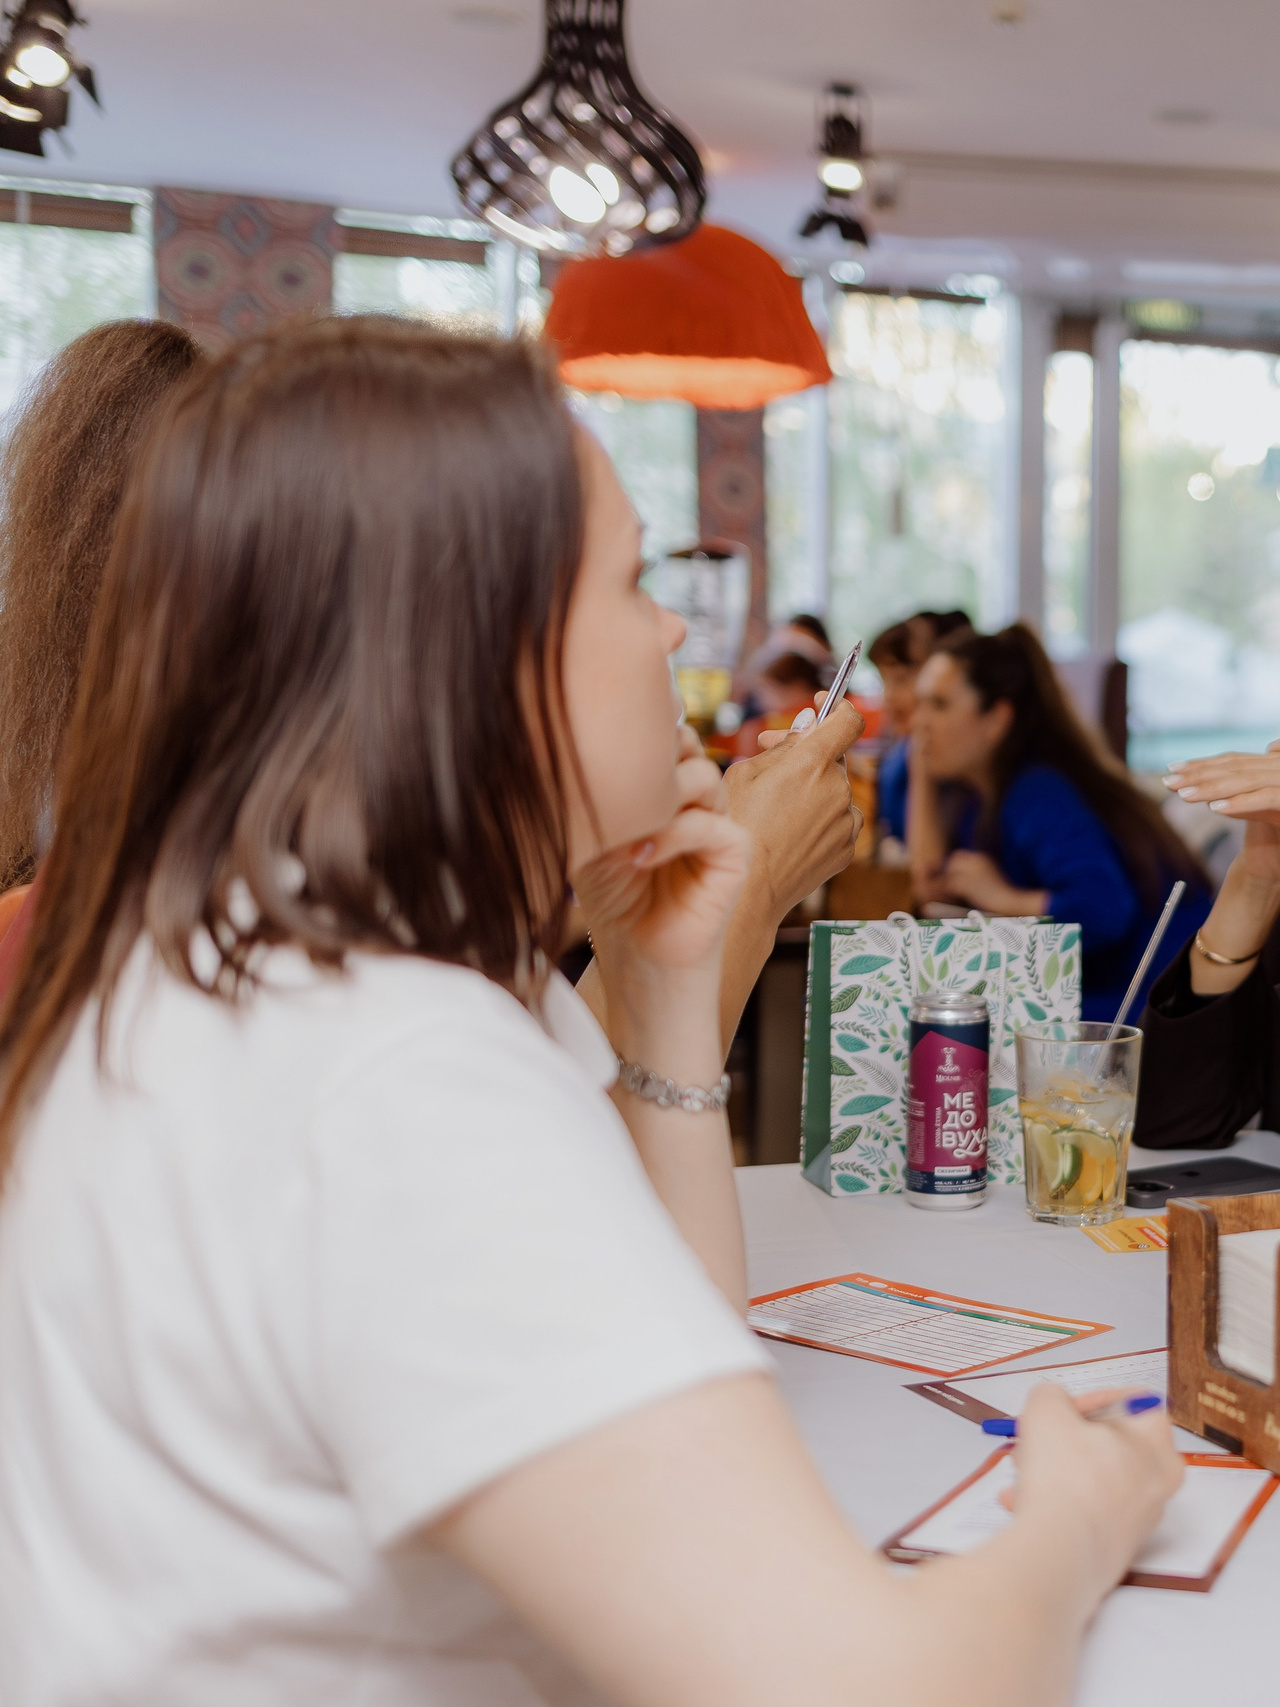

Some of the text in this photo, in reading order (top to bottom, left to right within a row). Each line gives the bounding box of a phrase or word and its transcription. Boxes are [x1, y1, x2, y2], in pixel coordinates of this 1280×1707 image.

[943, 1091, 974, 1109] МЕ
[942, 1110, 977, 1129] ДО
[942, 1127, 988, 1158] ВУХА
